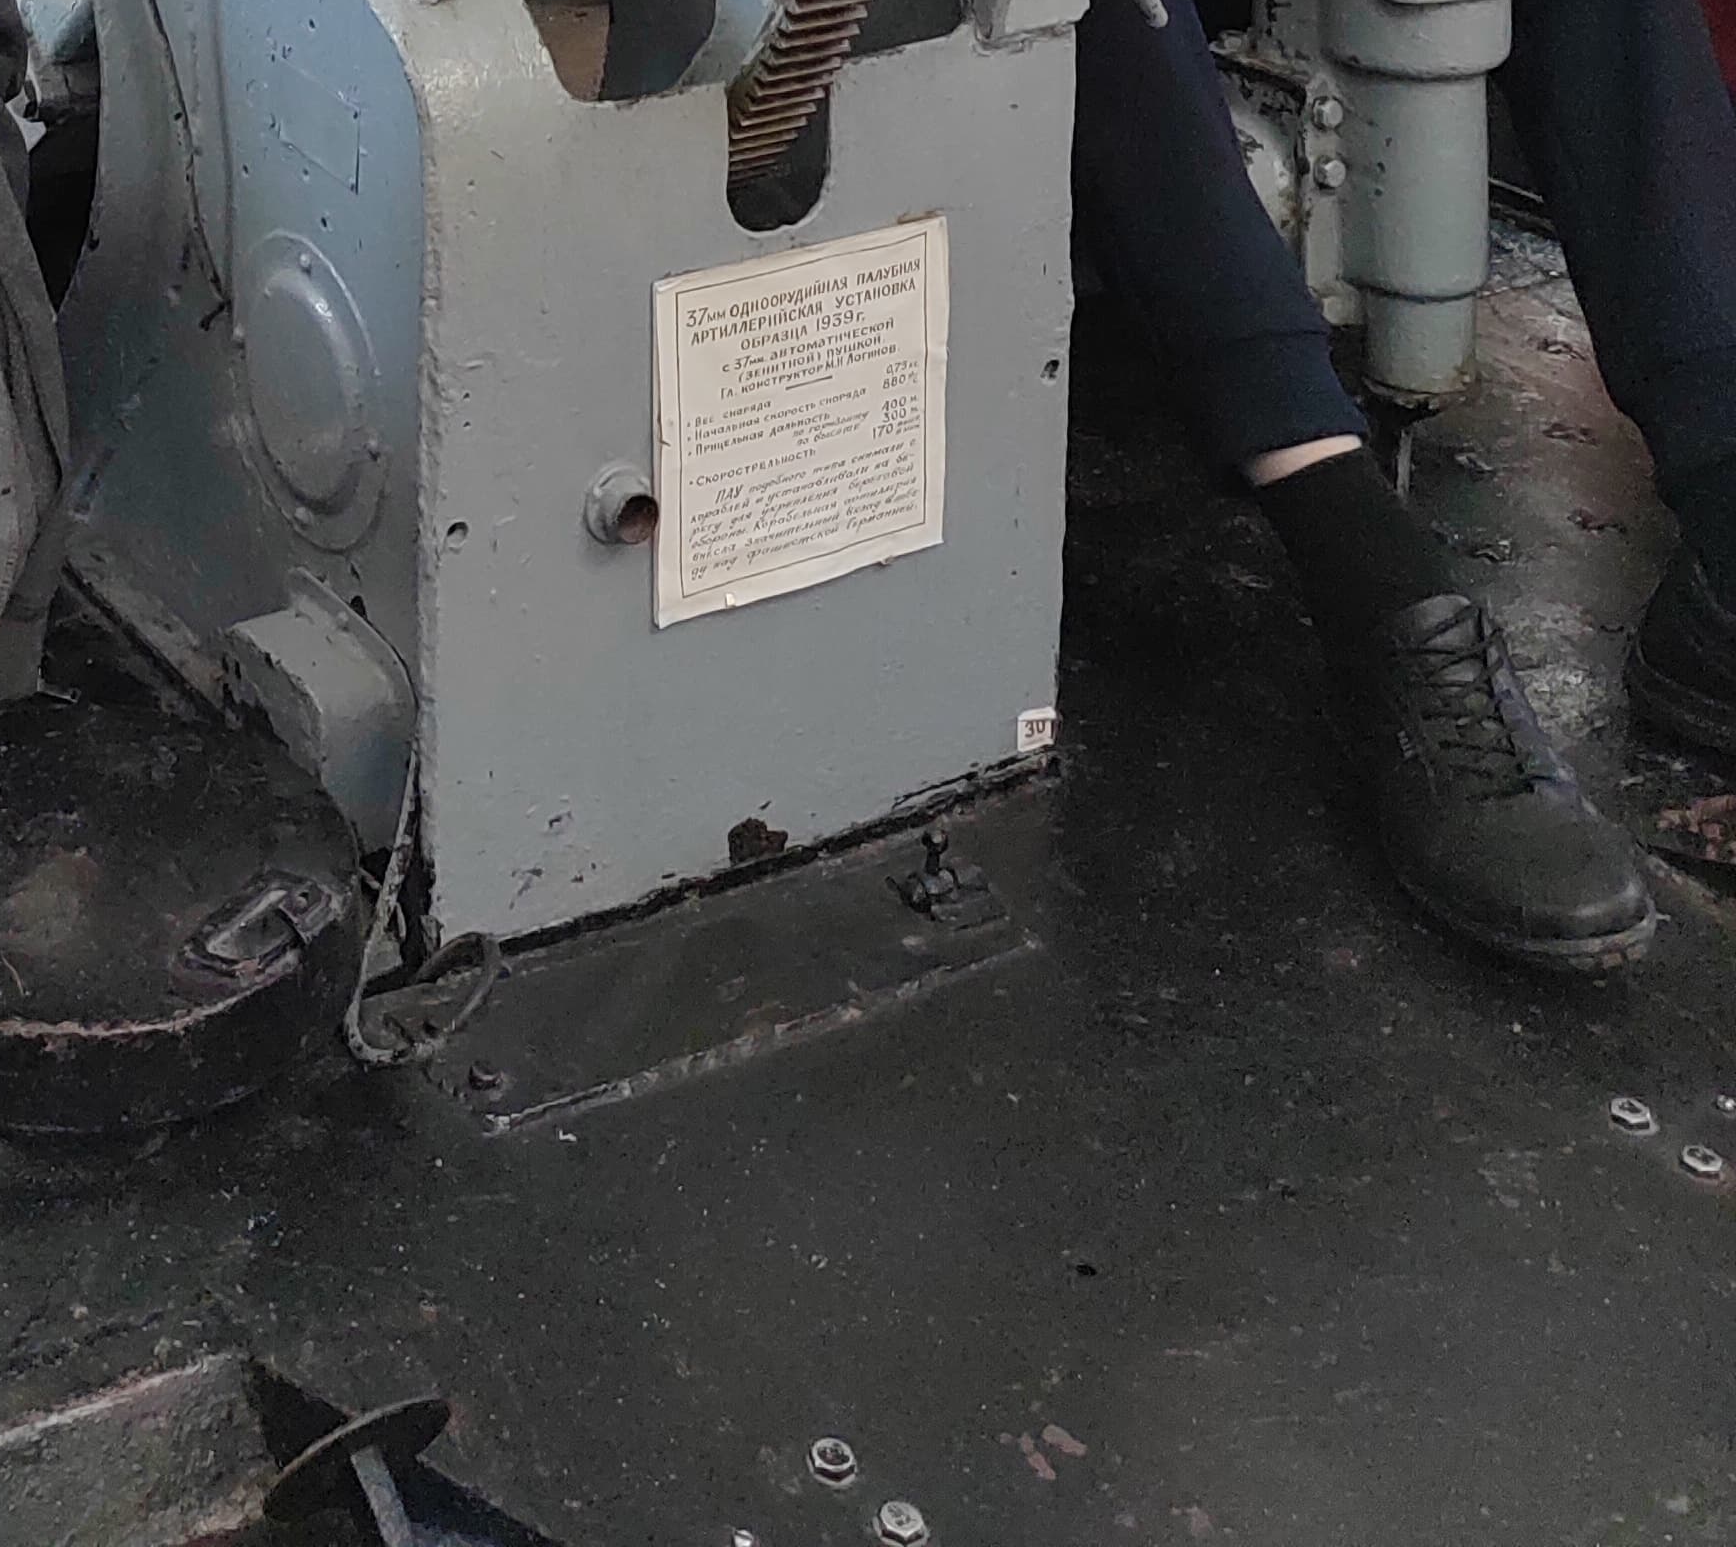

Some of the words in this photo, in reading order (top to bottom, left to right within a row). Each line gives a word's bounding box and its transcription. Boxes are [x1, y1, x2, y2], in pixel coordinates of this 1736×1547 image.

[691, 300, 822, 346] АРТИЛЛЕРИЙСКАЯ
[835, 277, 915, 310] УСТАНОВКА
[730, 276, 847, 318] ОДНООРУДИЙНАЯ
[857, 258, 920, 286] ПАЛУБНАЯ
[740, 323, 806, 352] ОБРАЗЦА
